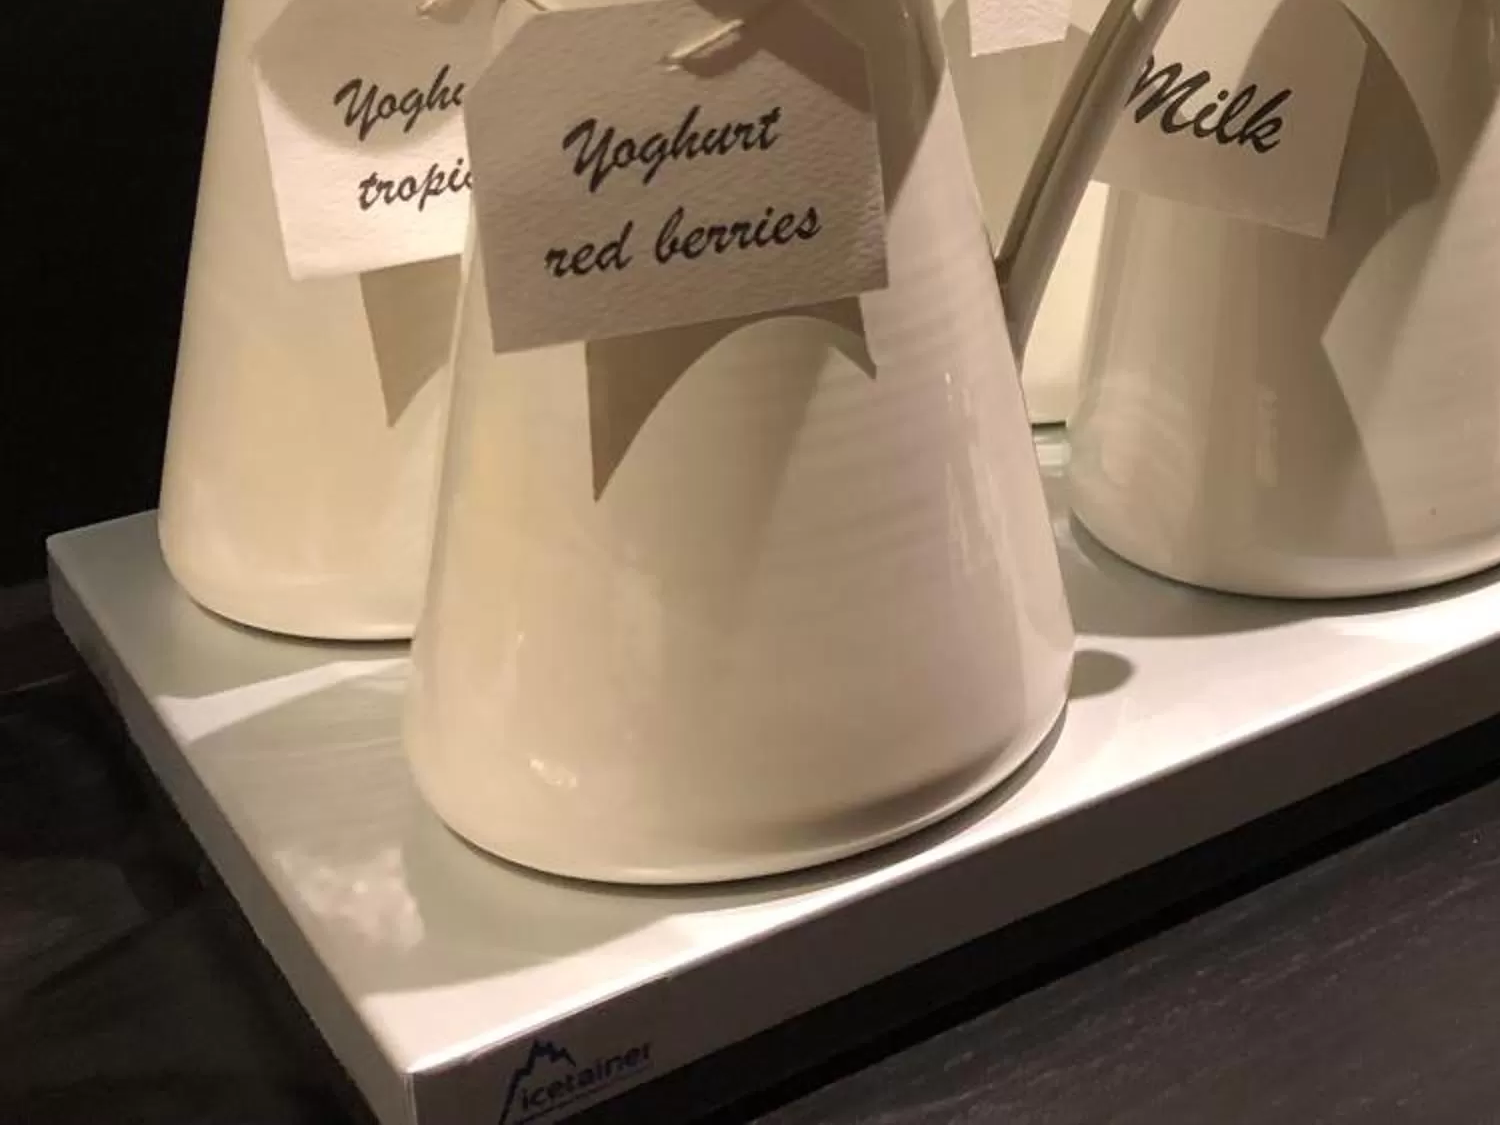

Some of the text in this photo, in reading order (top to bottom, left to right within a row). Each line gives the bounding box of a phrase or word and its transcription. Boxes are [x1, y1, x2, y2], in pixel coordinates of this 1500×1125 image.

[1124, 54, 1292, 154] Milk
[562, 105, 783, 193] Yoghurt
[544, 205, 823, 277] red berries
